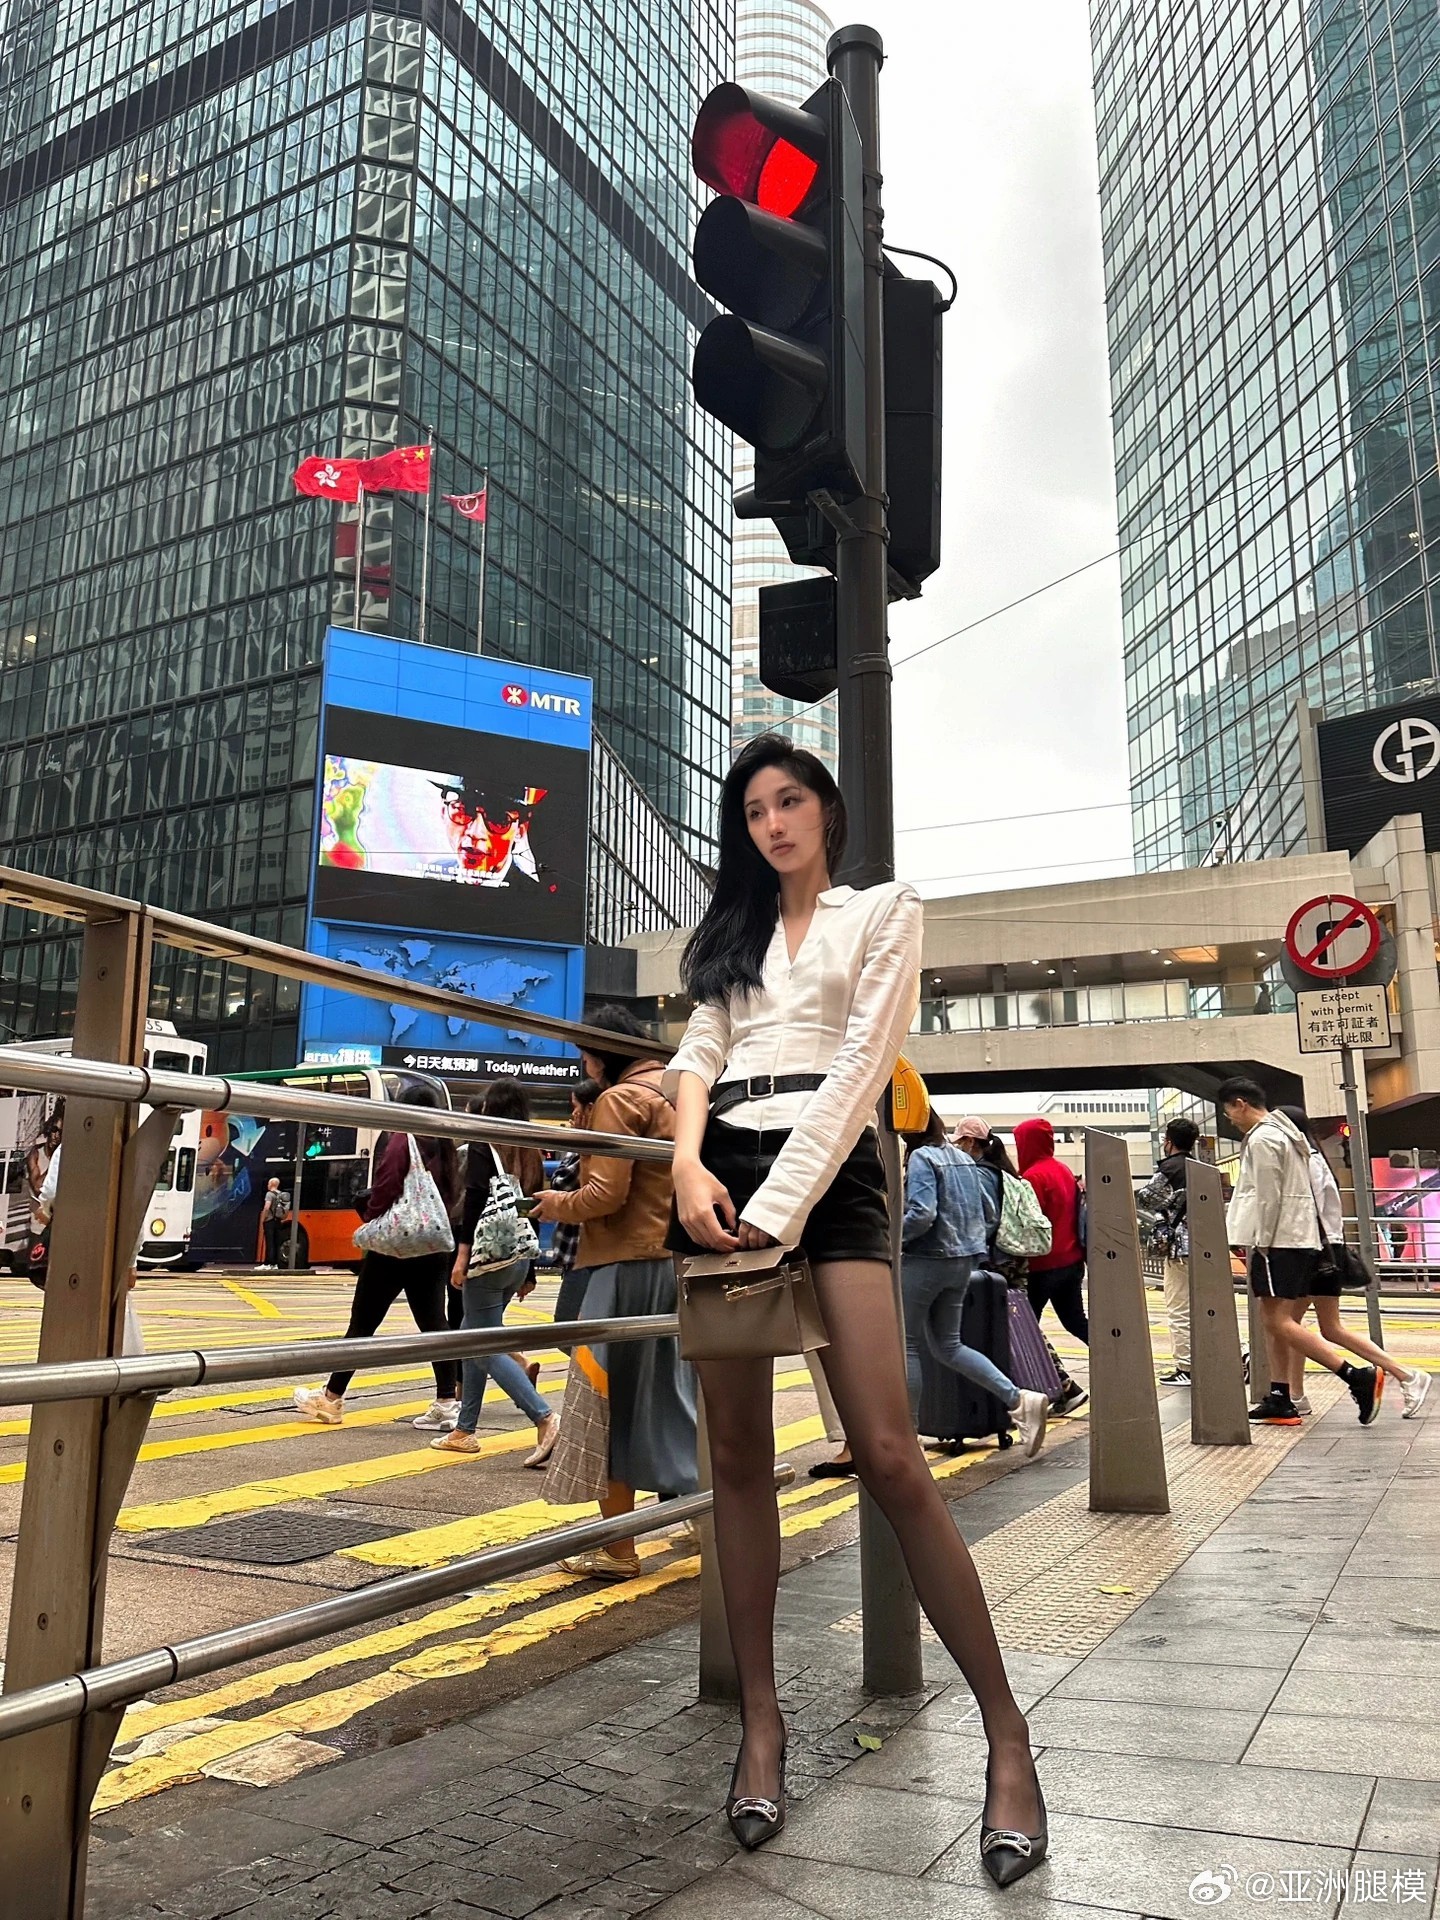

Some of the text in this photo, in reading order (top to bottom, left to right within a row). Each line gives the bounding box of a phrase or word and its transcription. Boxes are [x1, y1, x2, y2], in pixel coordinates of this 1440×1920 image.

[530, 691, 581, 716] MTR
[1321, 990, 1360, 1003] Except
[1311, 1003, 1374, 1016] with permit
[1307, 1016, 1379, 1033] 有許可証者
[1316, 1031, 1374, 1047] 不在此限
[402, 1054, 479, 1072] 今日天氣預測
[485, 1060, 522, 1076] Today
[521, 1062, 569, 1077] Weather
